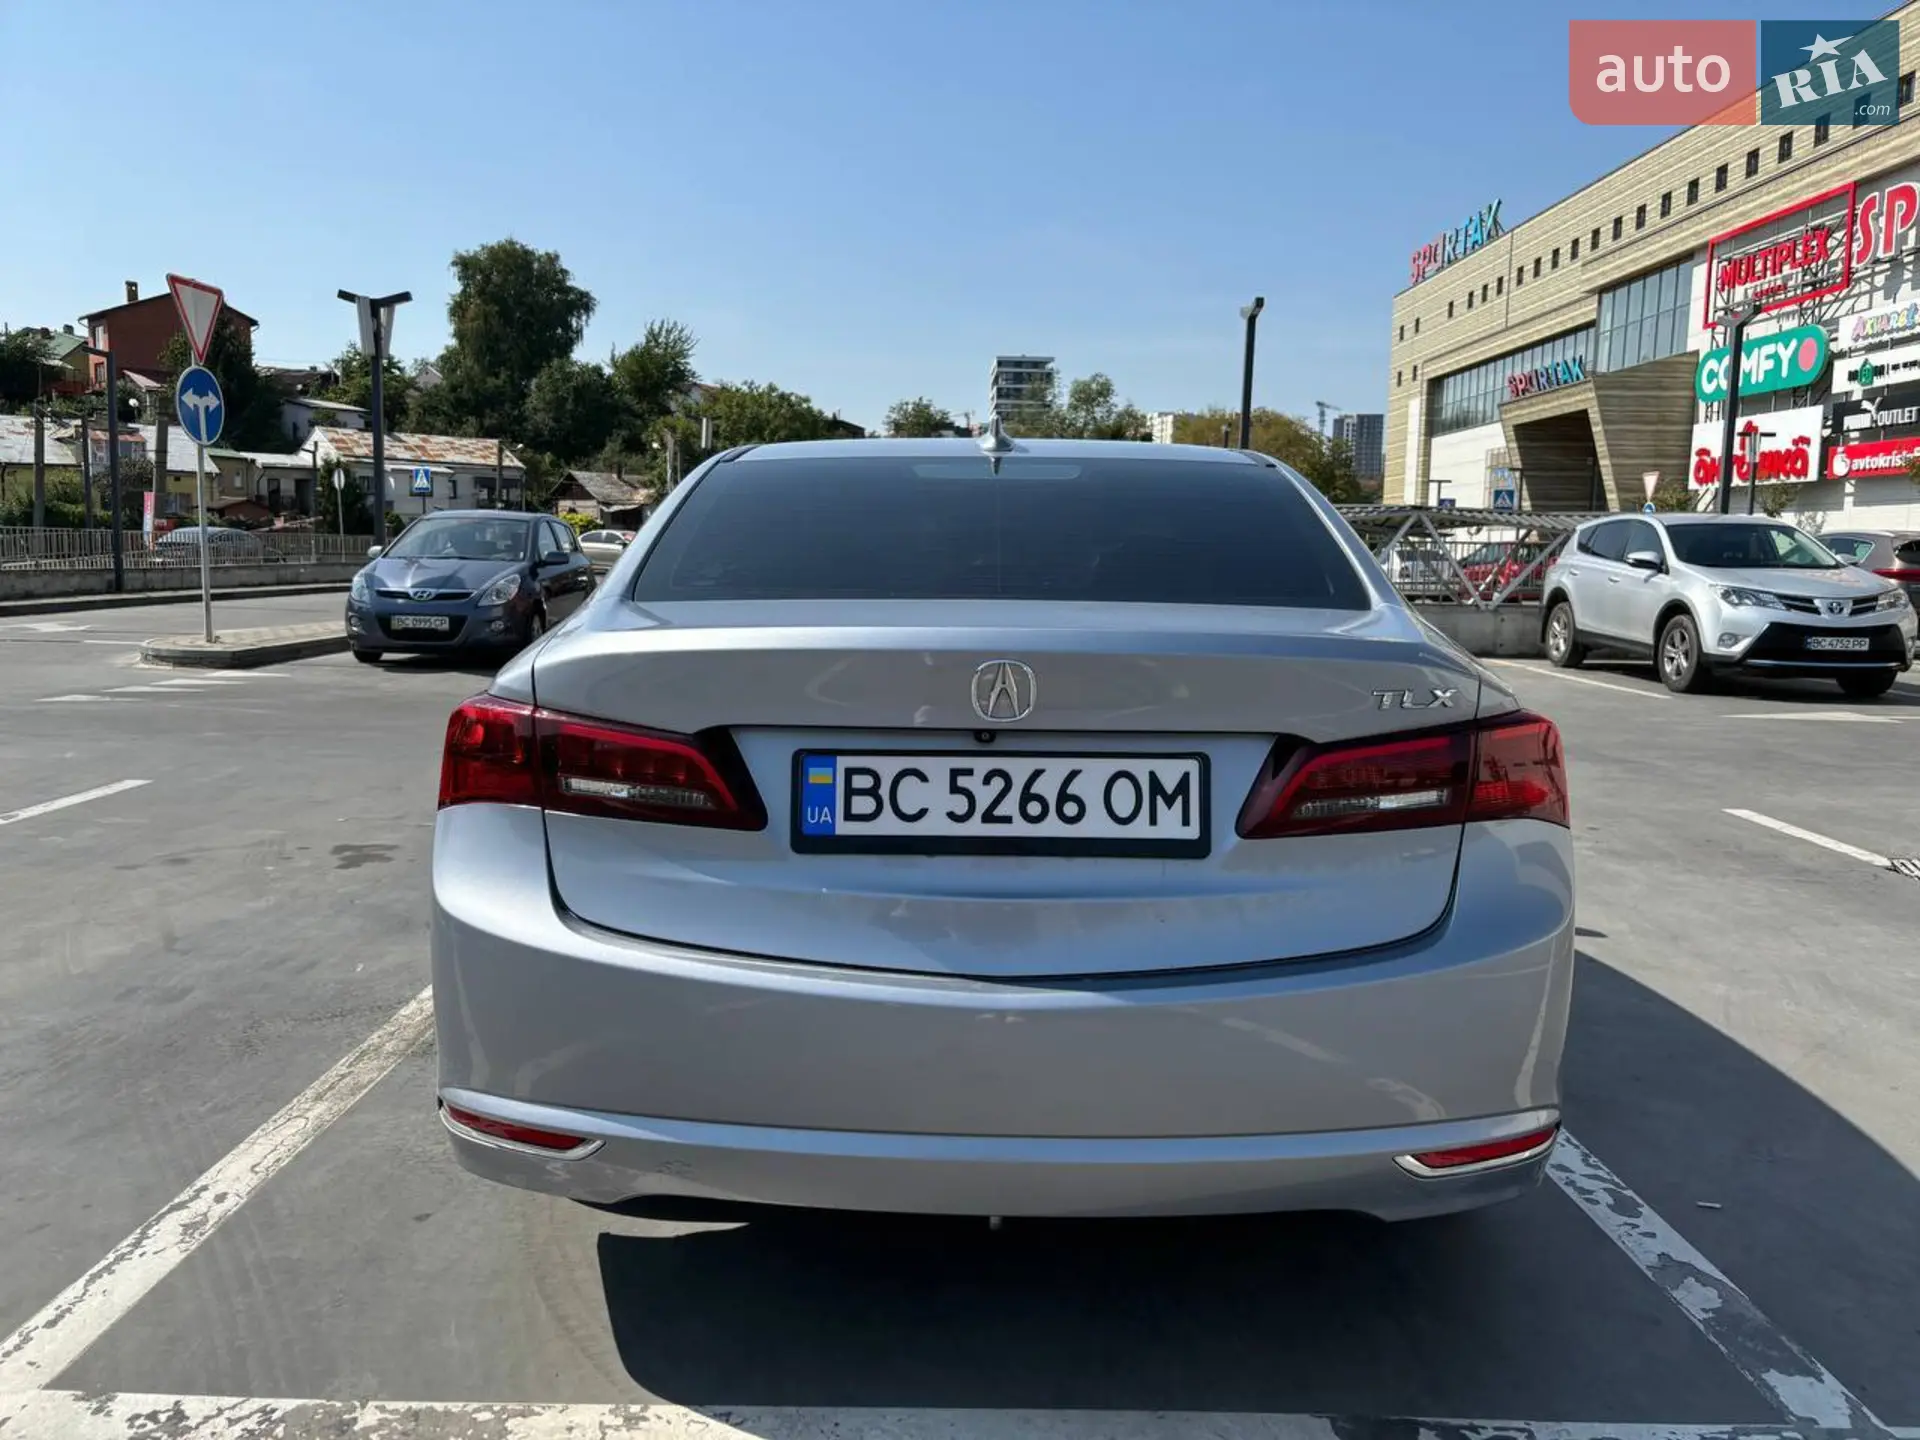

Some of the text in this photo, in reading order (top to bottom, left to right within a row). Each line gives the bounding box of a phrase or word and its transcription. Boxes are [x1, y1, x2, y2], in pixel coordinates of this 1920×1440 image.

[1719, 226, 1830, 292] MULTIPLEX
[1702, 338, 1797, 394] COMFY
[1877, 406, 1920, 426] OUTLET
[1812, 638, 1826, 649] BC
[1372, 689, 1457, 709] TLX
[807, 767, 1191, 827] UA BC 5266 OM
